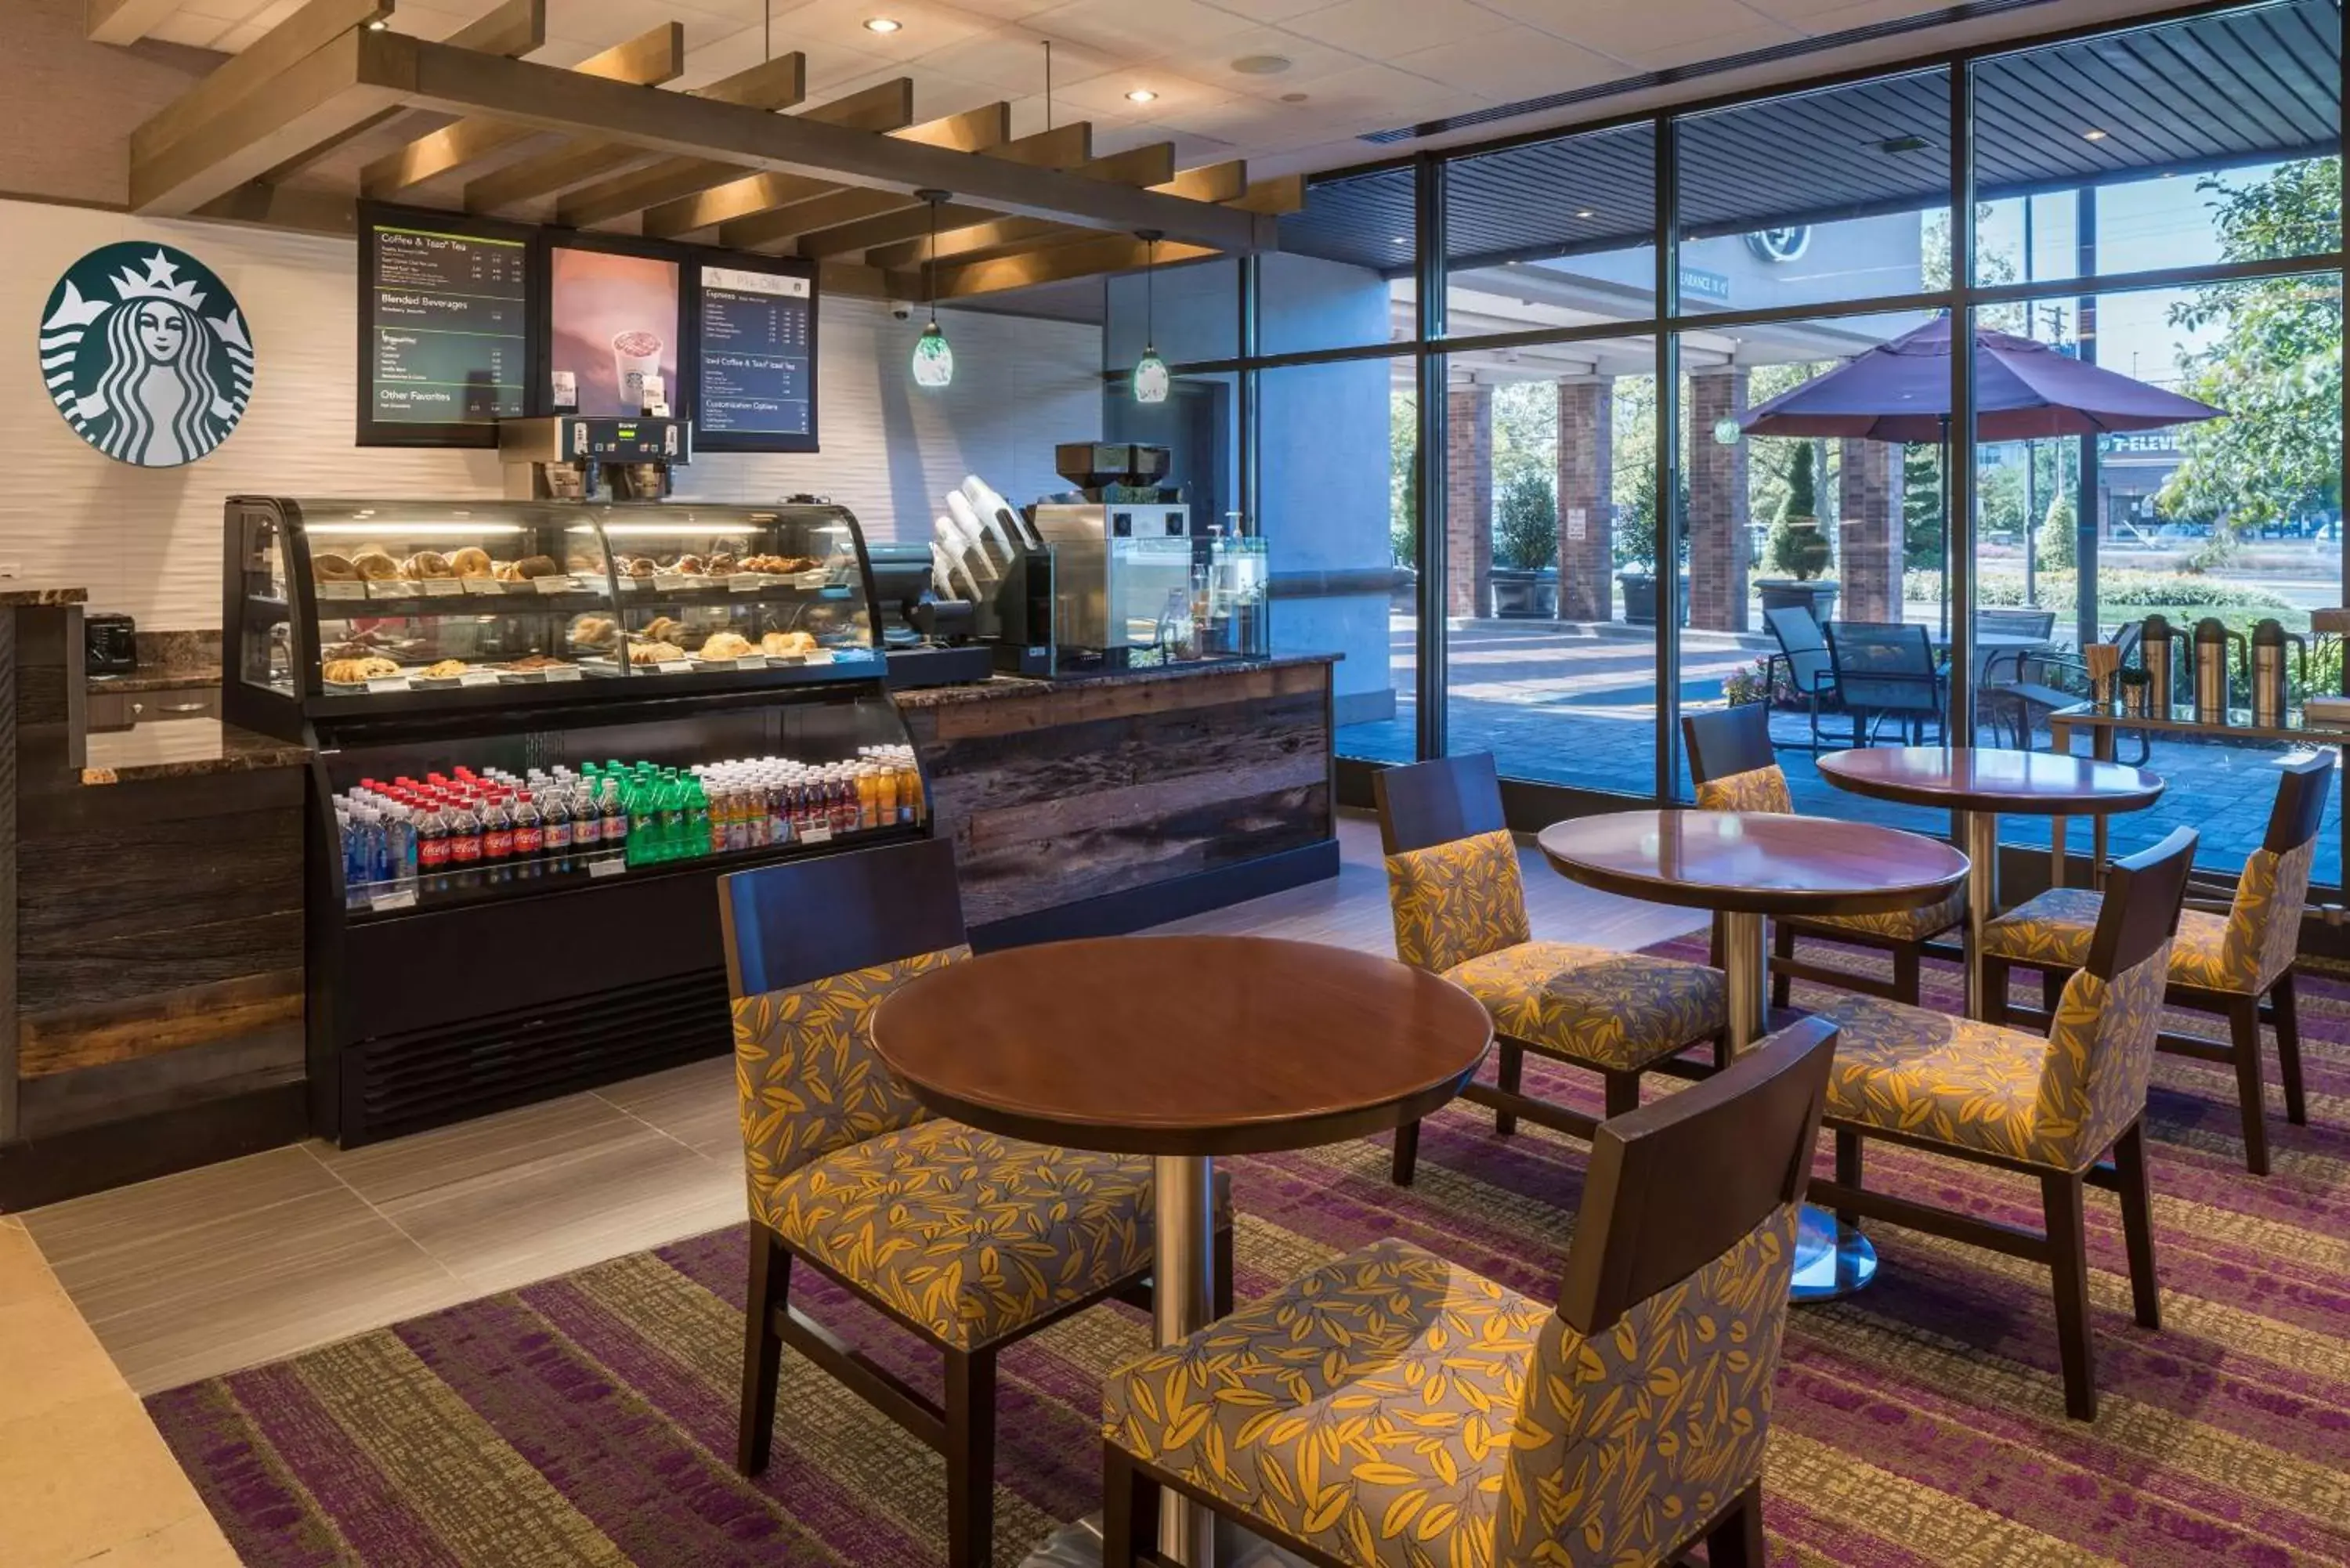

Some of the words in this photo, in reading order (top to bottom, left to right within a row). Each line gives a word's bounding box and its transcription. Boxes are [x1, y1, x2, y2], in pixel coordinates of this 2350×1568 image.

[381, 233, 413, 244] Coffee
[415, 237, 423, 246] &
[451, 240, 466, 251] Tea
[381, 294, 419, 305] Blended
[422, 297, 468, 310] Beverages
[380, 389, 407, 401] Other
[410, 391, 450, 402] Favorites
[706, 399, 753, 409] Customization
